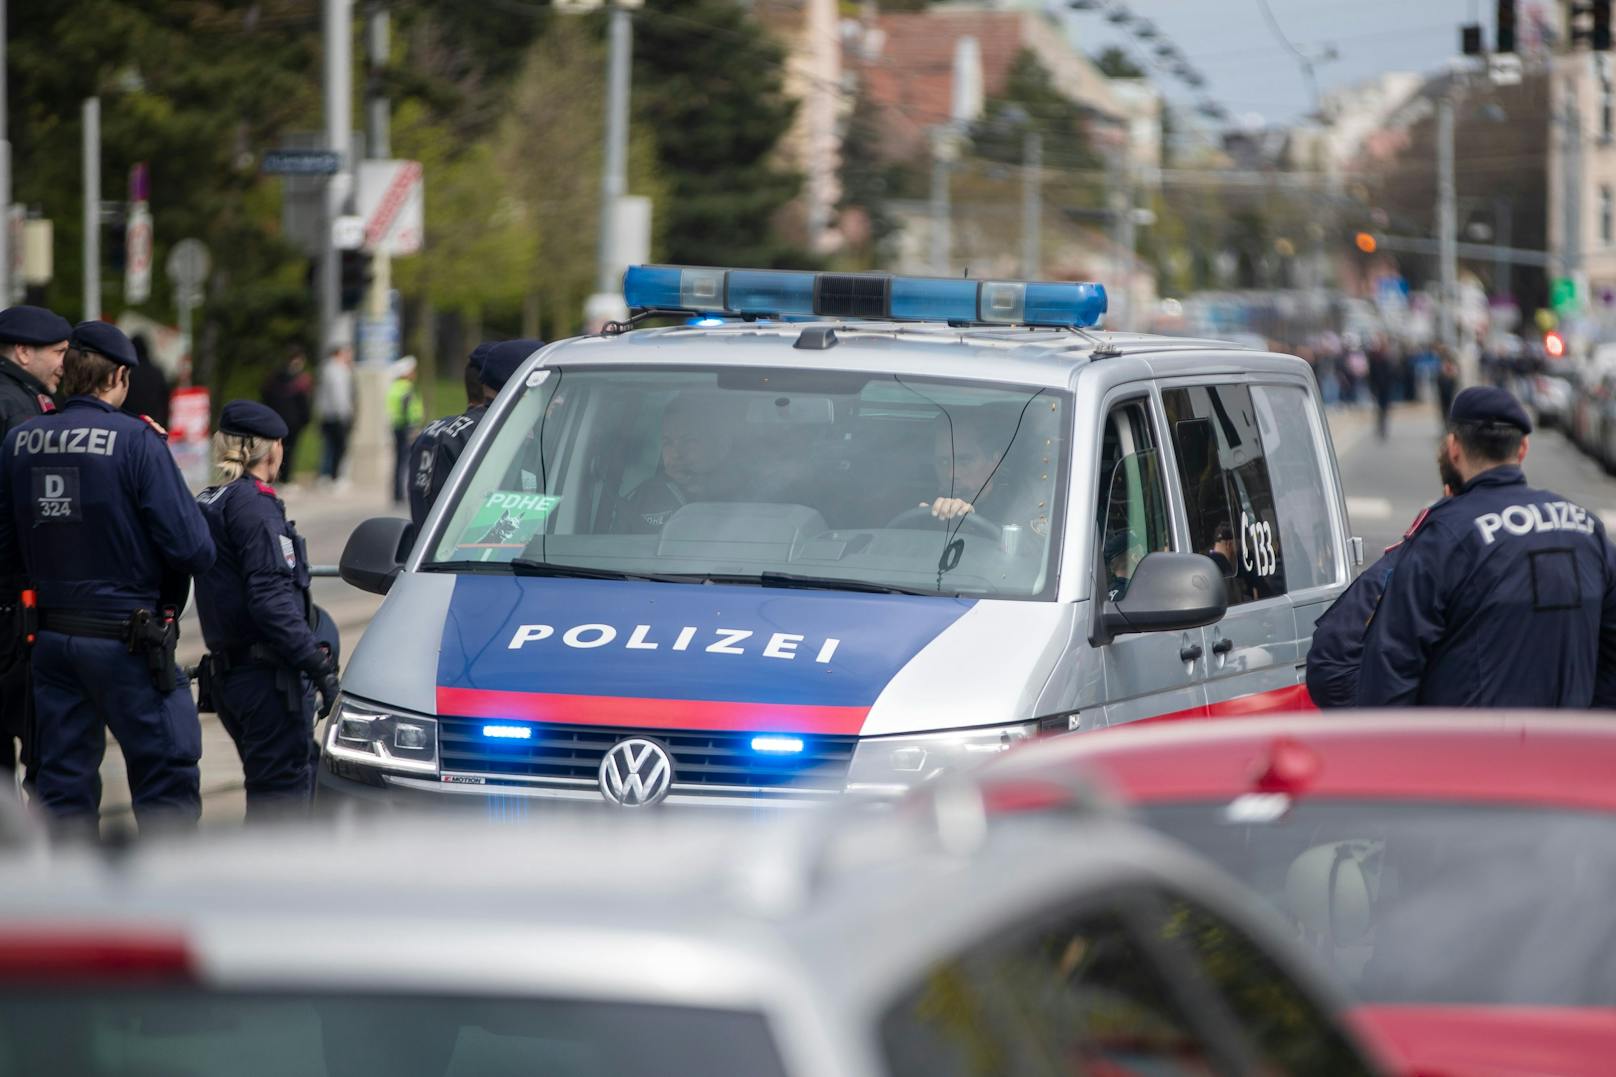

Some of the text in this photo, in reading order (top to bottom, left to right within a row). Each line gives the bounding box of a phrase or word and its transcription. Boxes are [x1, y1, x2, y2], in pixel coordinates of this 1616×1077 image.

[13, 428, 118, 456] POLIZEI
[45, 475, 65, 498] D
[40, 502, 71, 517] 324
[486, 493, 556, 511] PDHE
[1249, 521, 1276, 577] 133
[507, 623, 840, 664] POLIZEI
